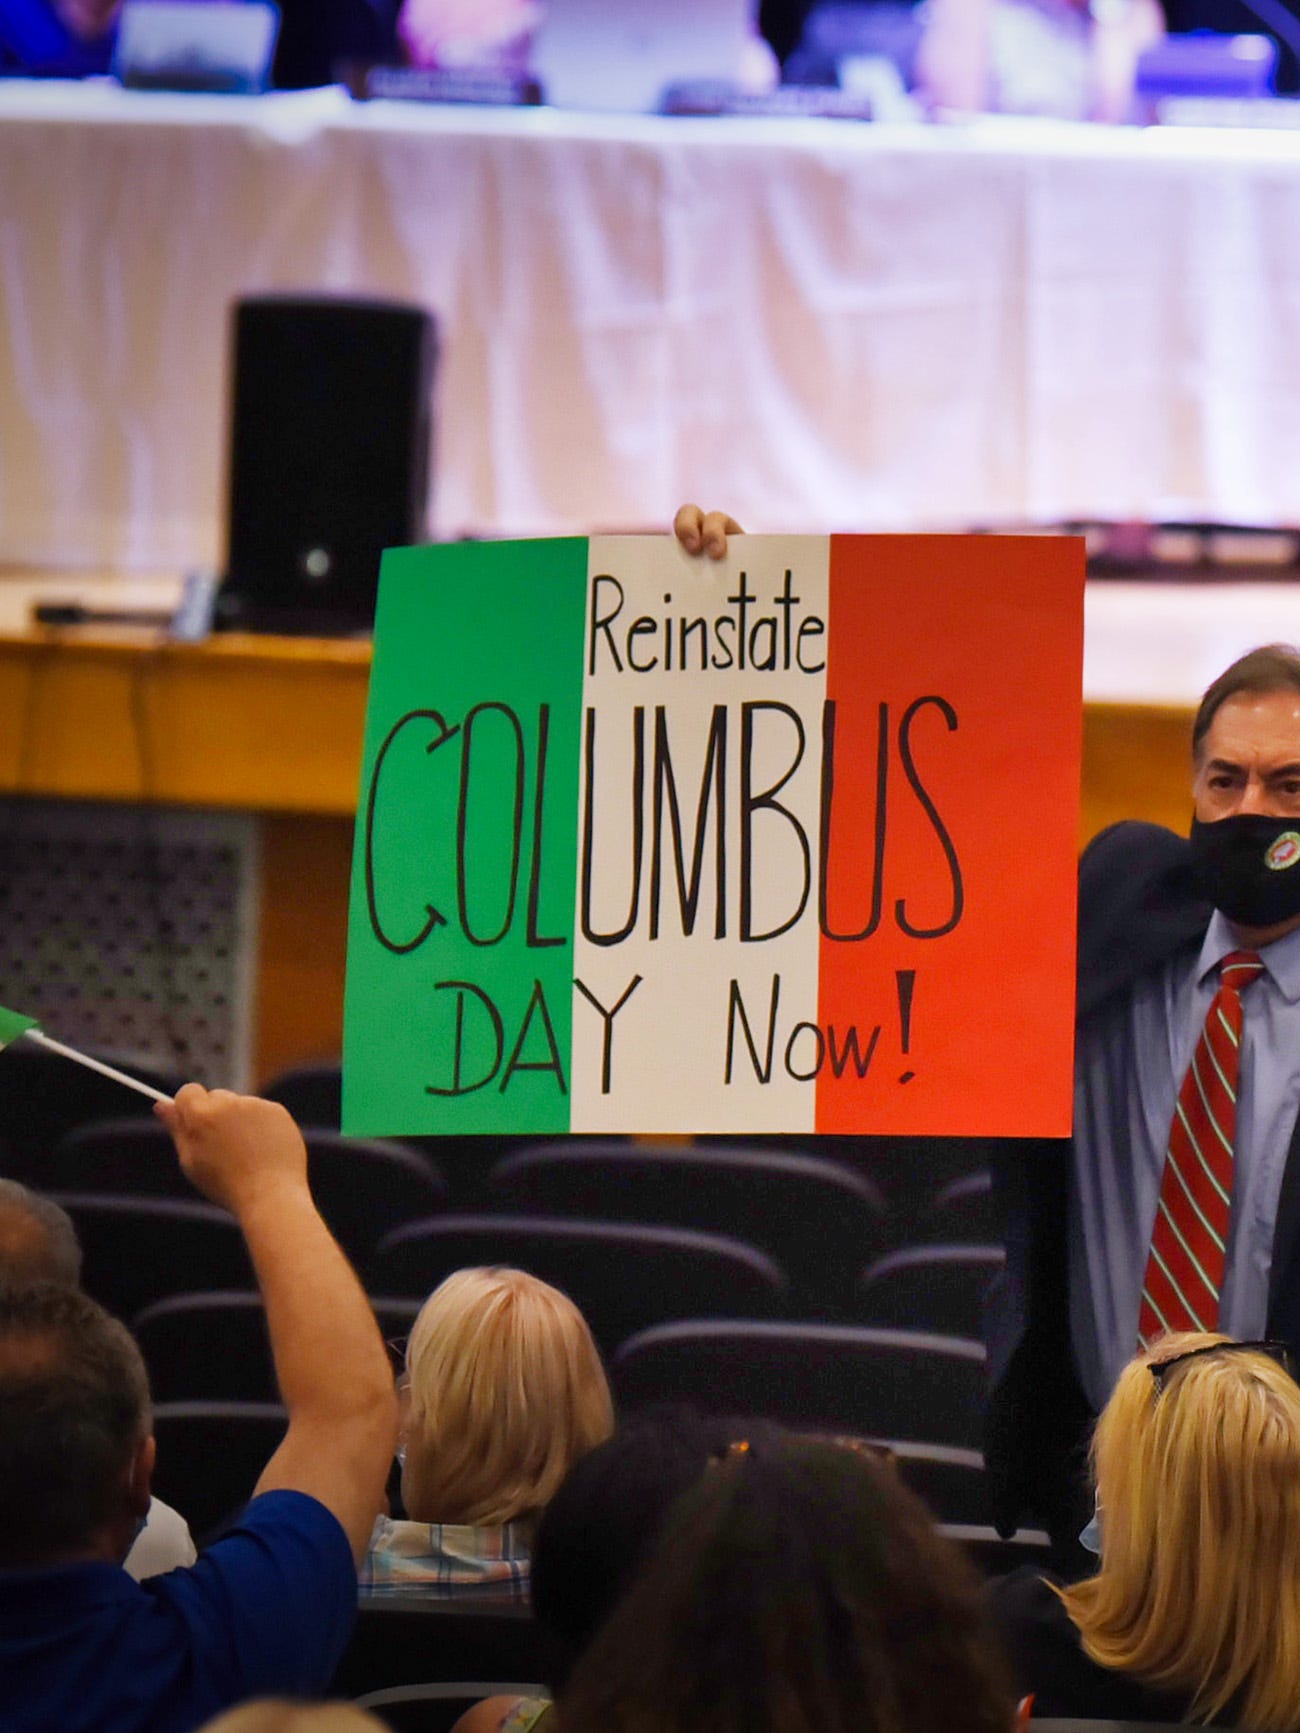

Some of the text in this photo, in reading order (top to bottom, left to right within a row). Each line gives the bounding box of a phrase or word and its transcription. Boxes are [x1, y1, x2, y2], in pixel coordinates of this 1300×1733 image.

[588, 569, 826, 676] Reinstate
[365, 695, 964, 955] COLUMBUS
[424, 974, 643, 1096] DAY
